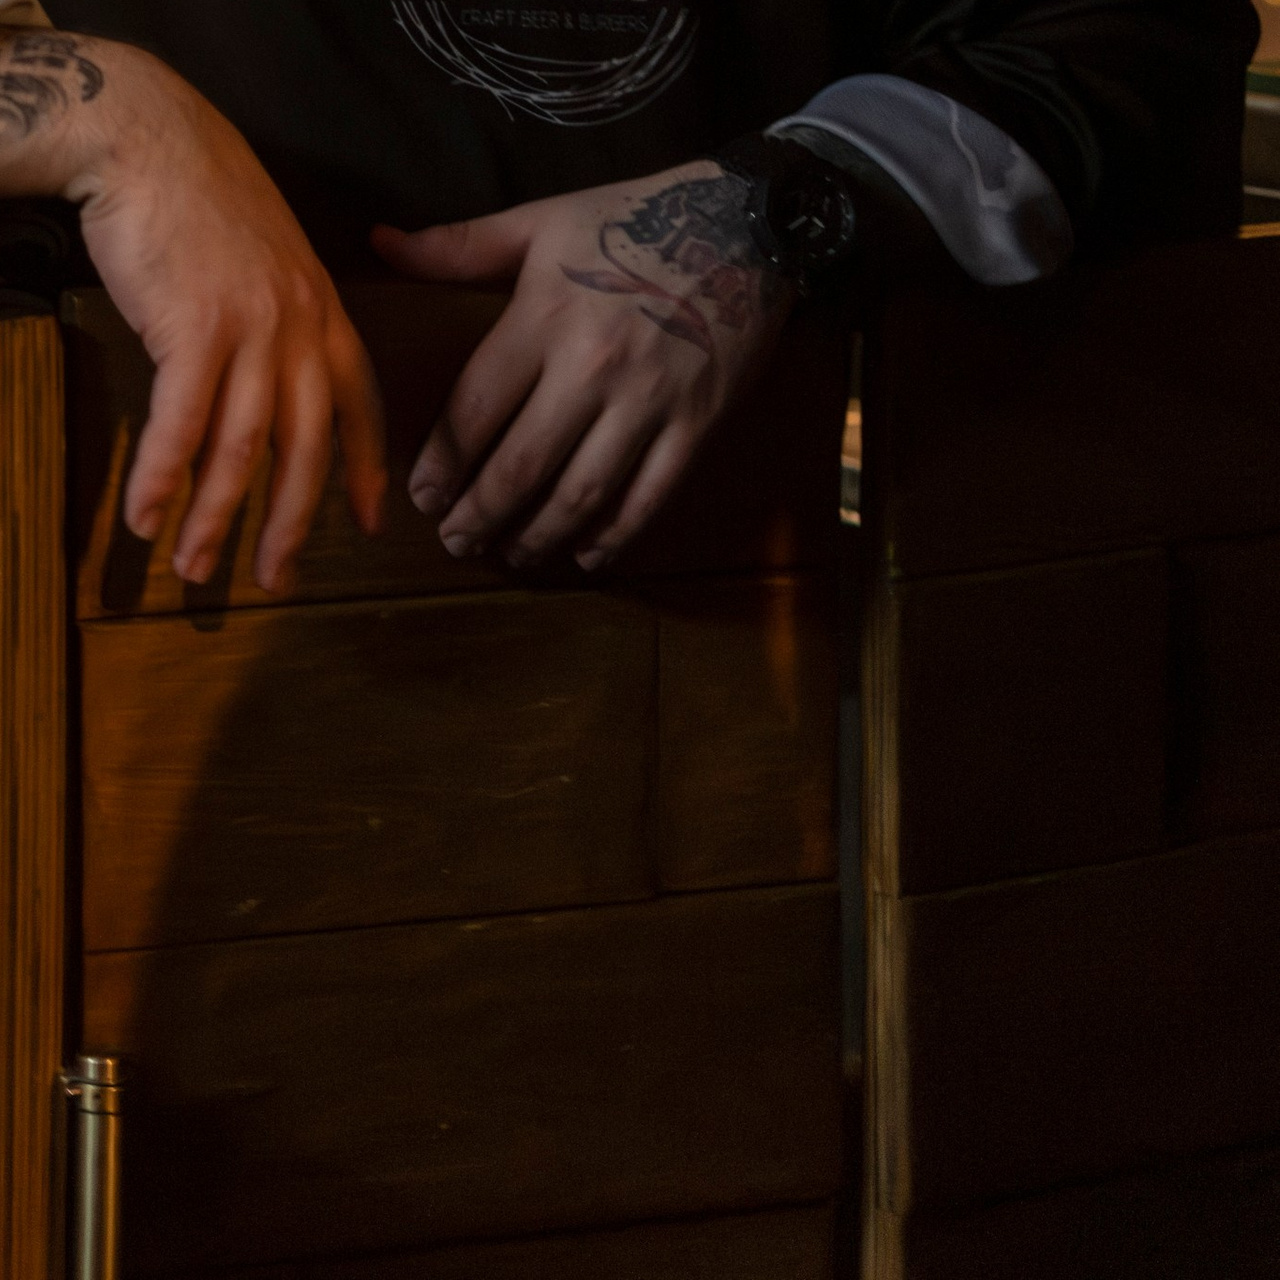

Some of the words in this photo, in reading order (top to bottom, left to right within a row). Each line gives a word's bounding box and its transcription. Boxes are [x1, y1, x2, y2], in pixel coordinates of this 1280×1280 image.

[461, 7, 515, 27] CRAFT
[520, 10, 559, 30] BEER
[578, 13, 649, 34] BURGERS
